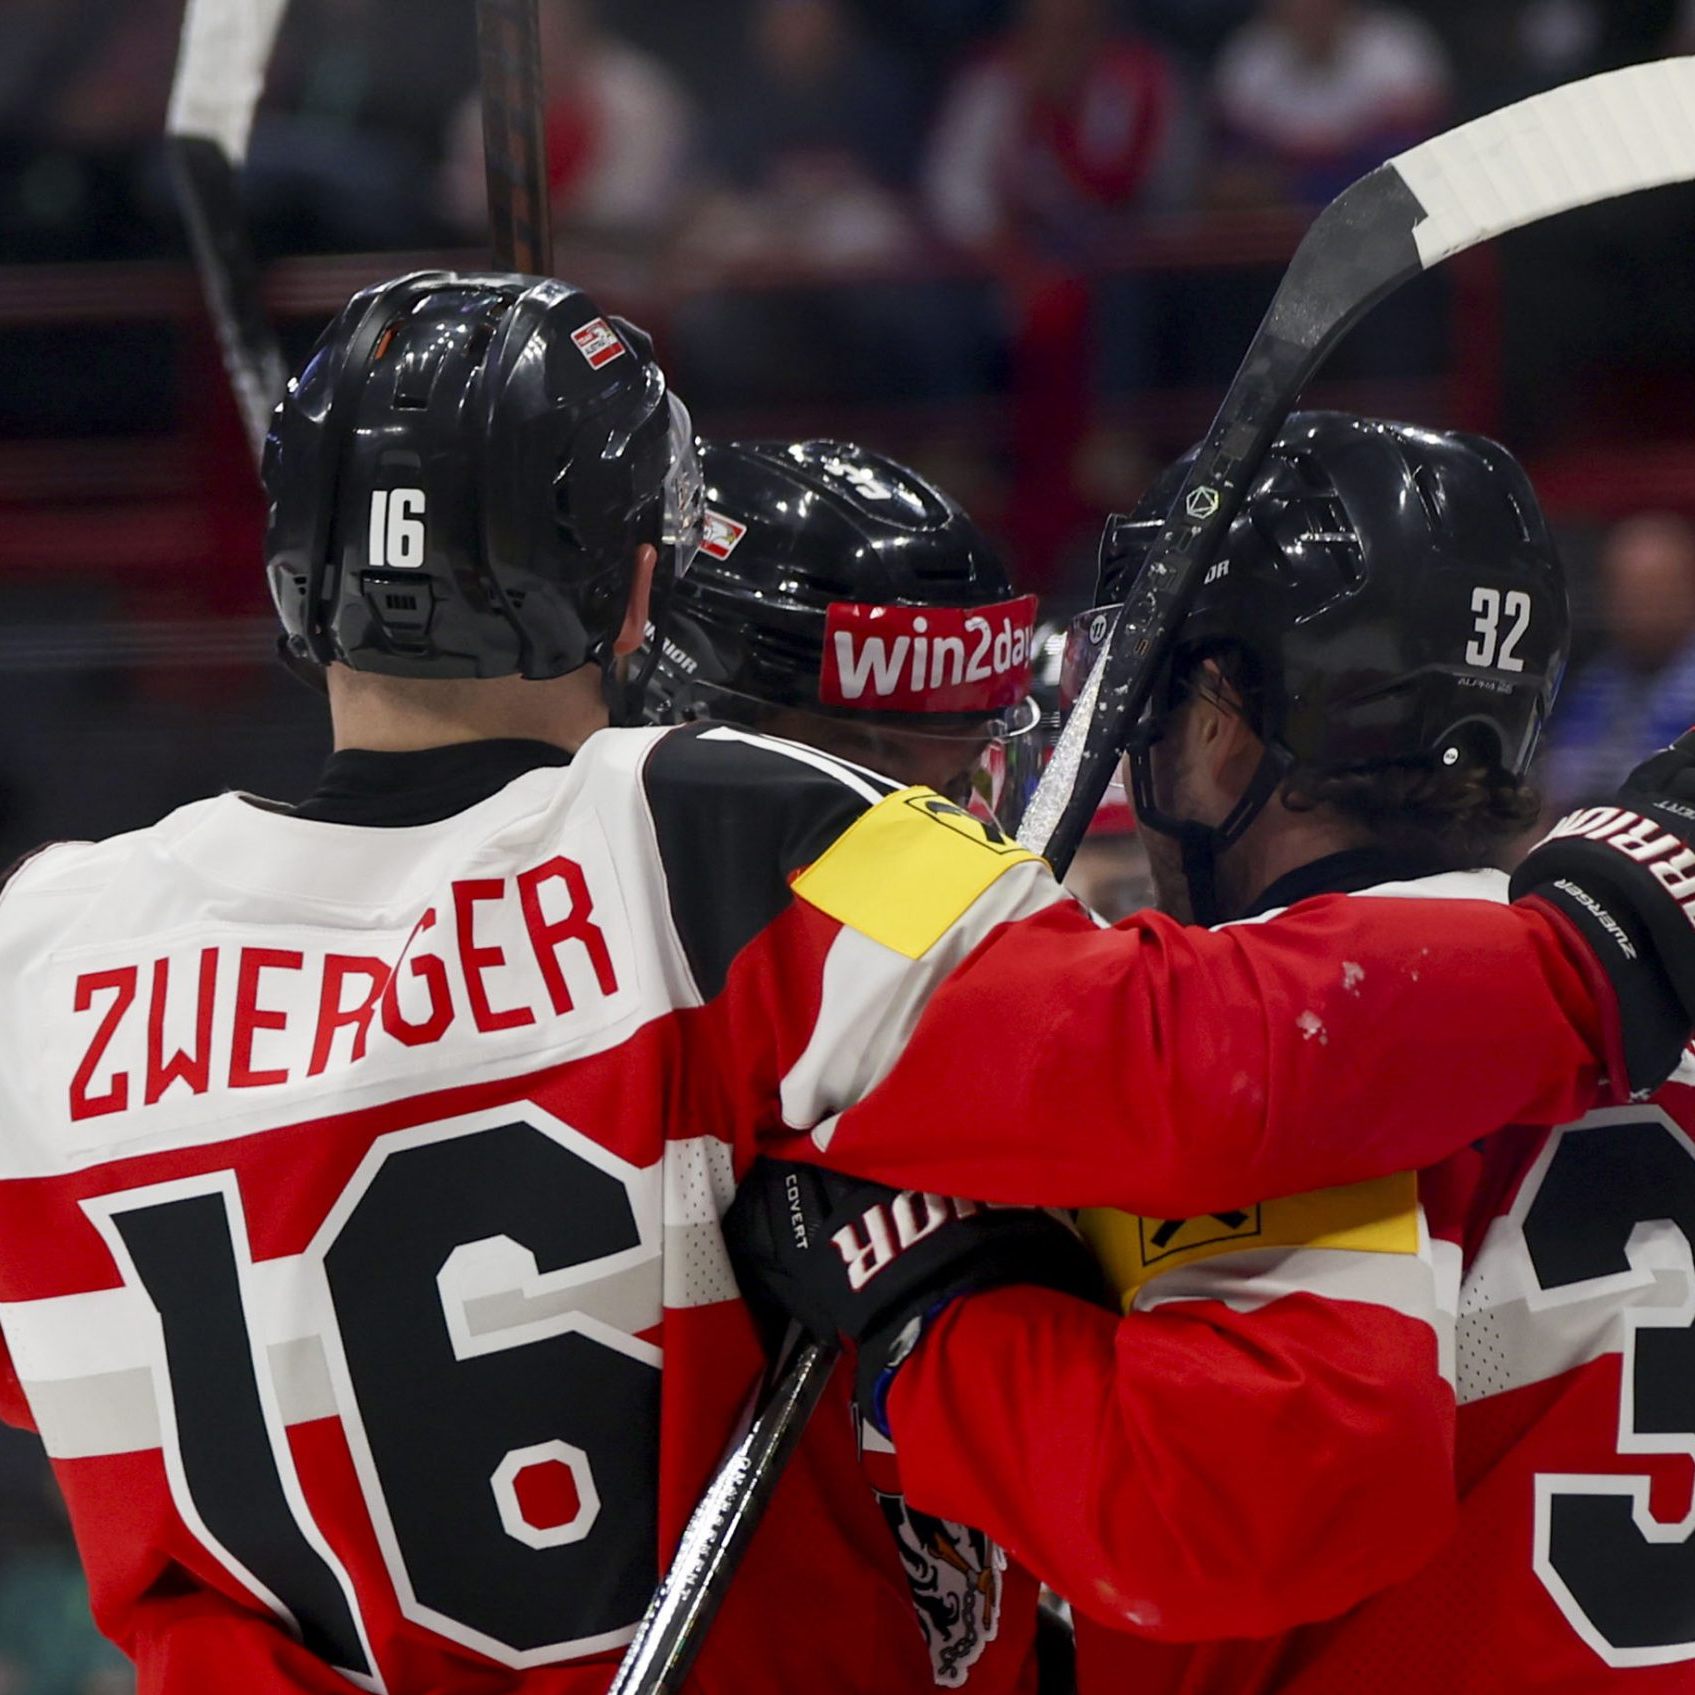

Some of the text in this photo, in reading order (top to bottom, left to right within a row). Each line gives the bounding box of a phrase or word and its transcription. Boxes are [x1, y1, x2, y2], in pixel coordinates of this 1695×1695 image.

[368, 487, 426, 568] 16
[1465, 586, 1531, 672] 32
[1553, 878, 1638, 960] ZWERGER
[70, 855, 620, 1123] ZWERGER
[785, 1173, 809, 1249] COVERT
[77, 1099, 664, 1694] 16
